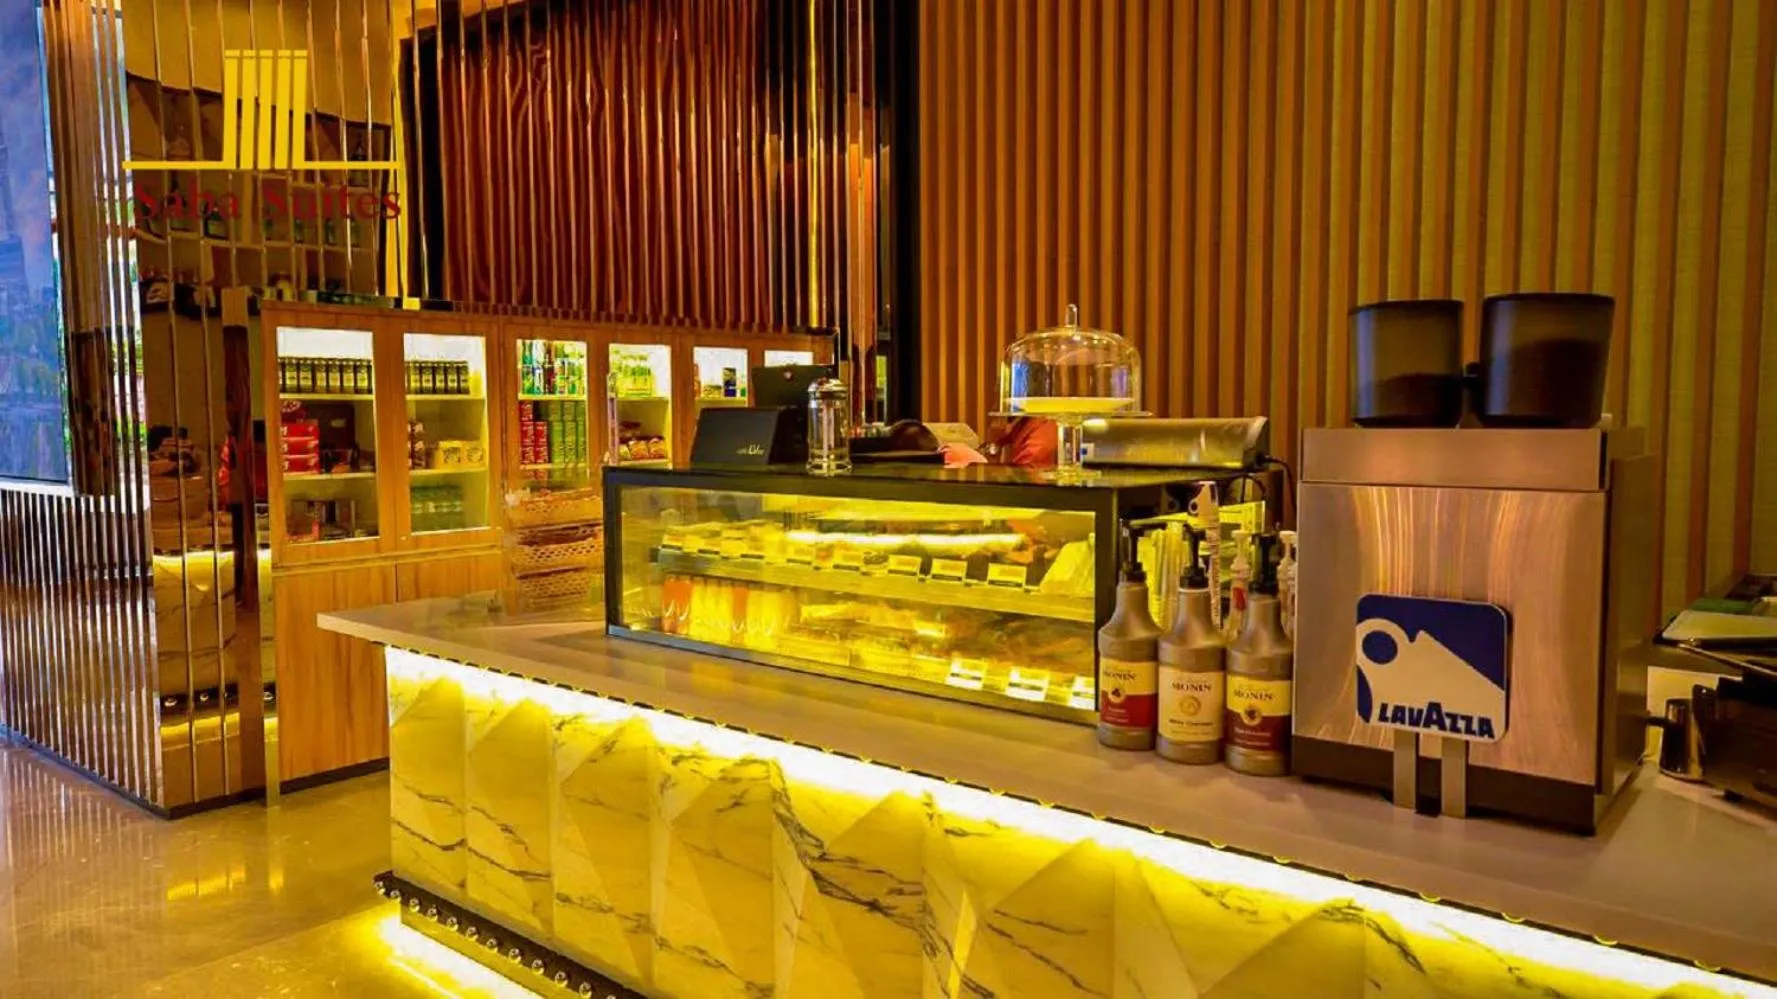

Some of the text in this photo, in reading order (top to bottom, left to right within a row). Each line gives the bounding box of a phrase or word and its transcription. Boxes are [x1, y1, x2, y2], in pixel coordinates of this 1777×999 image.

[1171, 681, 1212, 692] MONIN
[1233, 688, 1274, 701] MONIN
[1377, 701, 1496, 739] LAVAZZA
